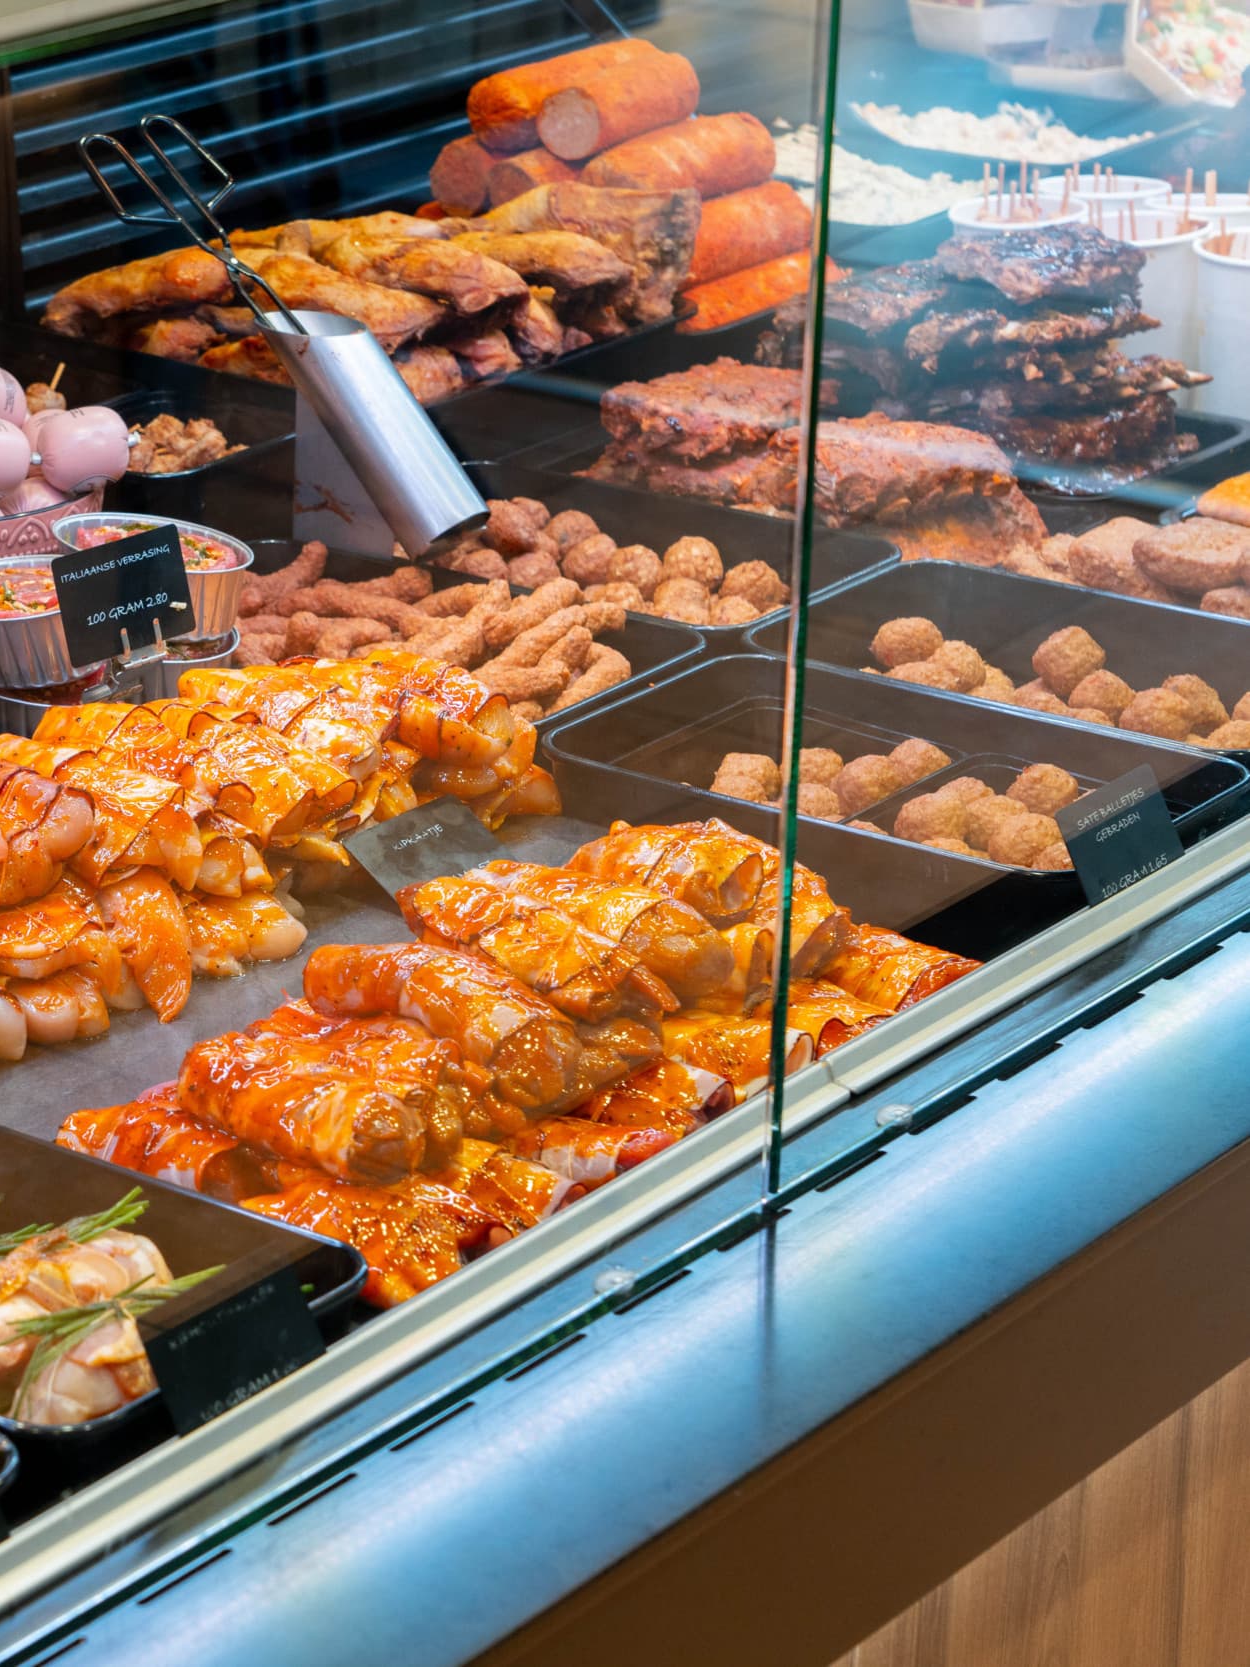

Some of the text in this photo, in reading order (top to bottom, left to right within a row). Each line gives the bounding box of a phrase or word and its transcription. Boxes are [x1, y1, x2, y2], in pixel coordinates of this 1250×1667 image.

[60, 544, 171, 583] ITALIAANSE VERRASING
[86, 592, 168, 626] 100 GRAM 2.80
[1099, 787, 1145, 817] BALLETJES
[1095, 811, 1142, 843] GEBRADEN
[1101, 882, 1118, 898] 100
[1147, 853, 1168, 874] 1.65
